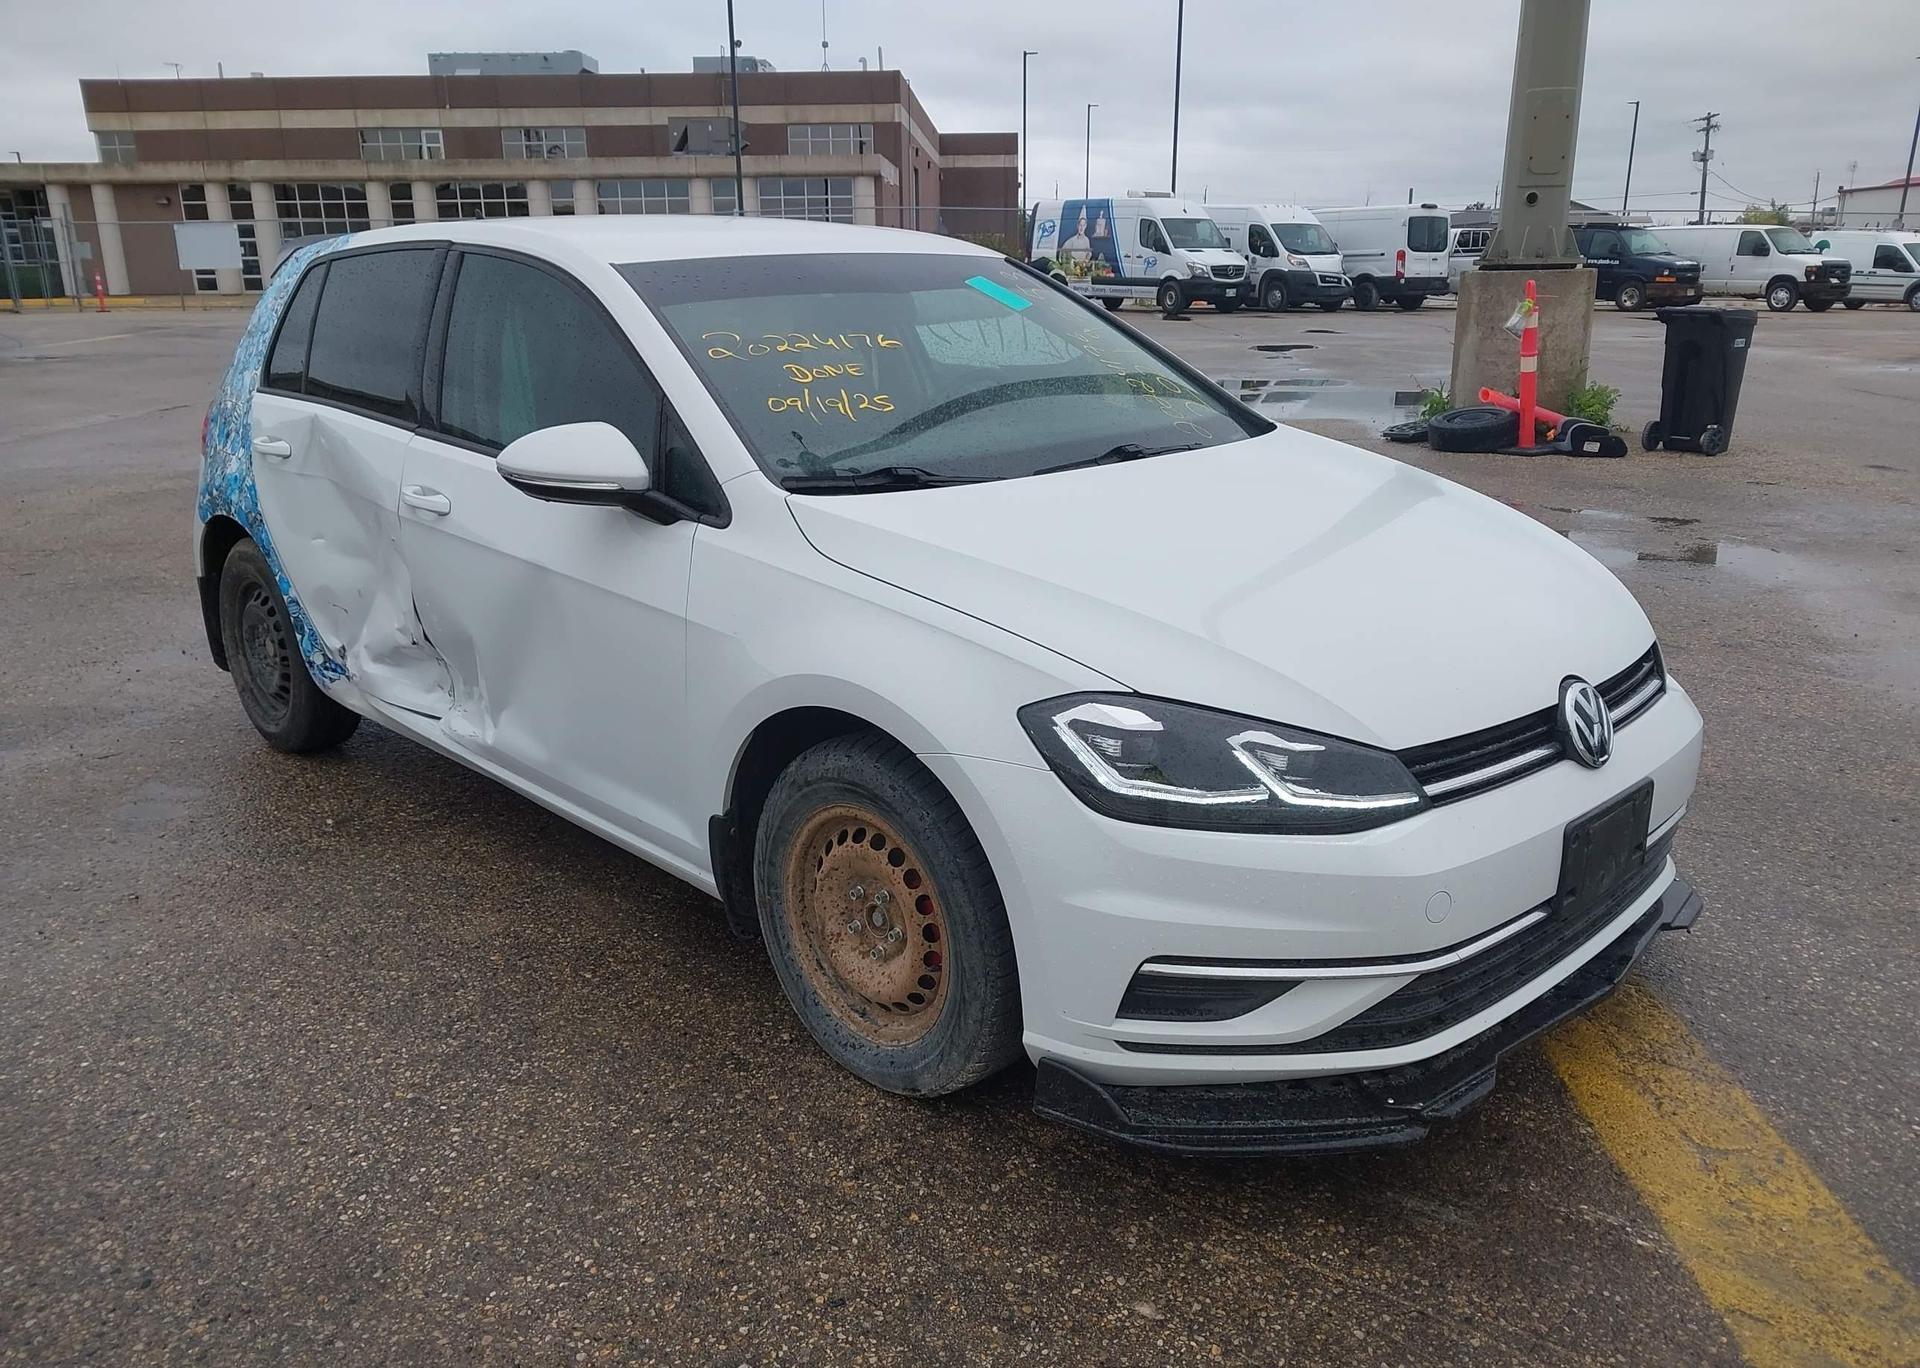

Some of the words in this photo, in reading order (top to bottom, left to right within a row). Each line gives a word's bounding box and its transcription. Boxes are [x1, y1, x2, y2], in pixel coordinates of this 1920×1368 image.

[702, 331, 904, 360] 20224176
[783, 363, 865, 383] DONE
[767, 388, 896, 425] 09/19/25
